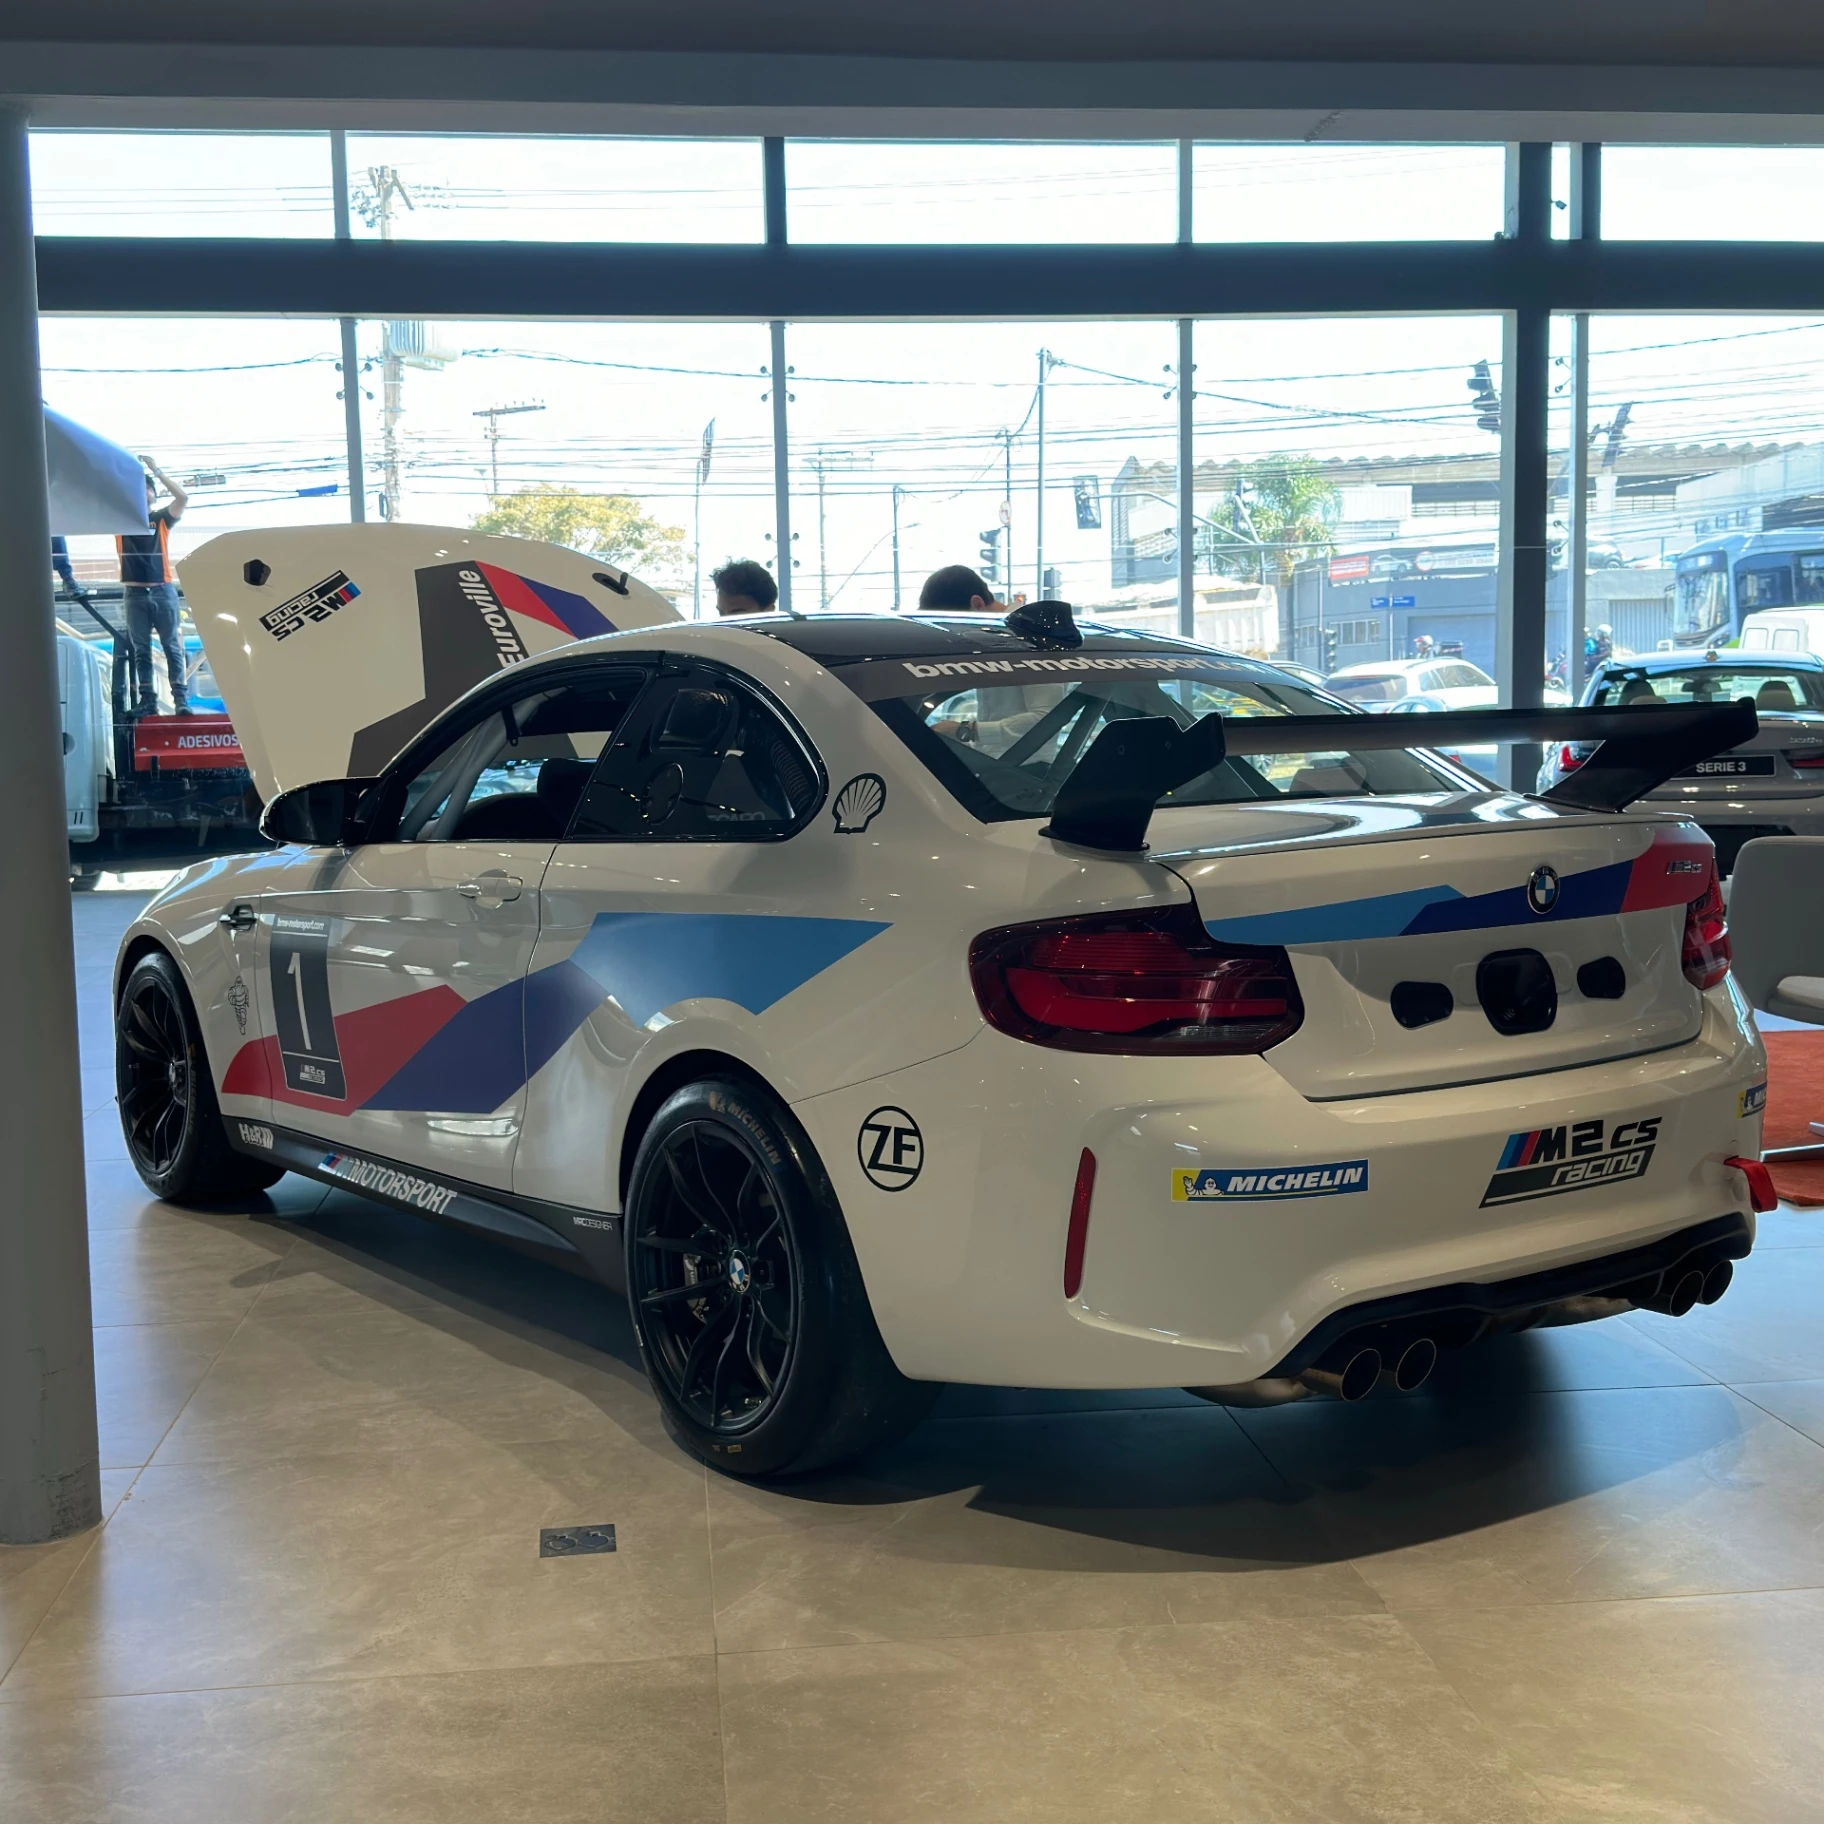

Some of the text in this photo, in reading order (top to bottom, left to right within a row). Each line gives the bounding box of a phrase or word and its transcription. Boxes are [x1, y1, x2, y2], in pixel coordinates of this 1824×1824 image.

[265, 591, 320, 627] racing
[458, 569, 526, 669] Euroville
[177, 734, 240, 748] ADESIVOS
[1696, 761, 1747, 773] SERIE 3
[287, 952, 313, 1051] 1
[727, 1102, 782, 1166] MICHELIN
[863, 1121, 920, 1176] ZF
[1528, 1119, 1605, 1165] M2
[347, 1157, 458, 1215] MOTORSPORT
[1226, 1167, 1364, 1192] MICHELIN
[1550, 1150, 1645, 1186] racing
